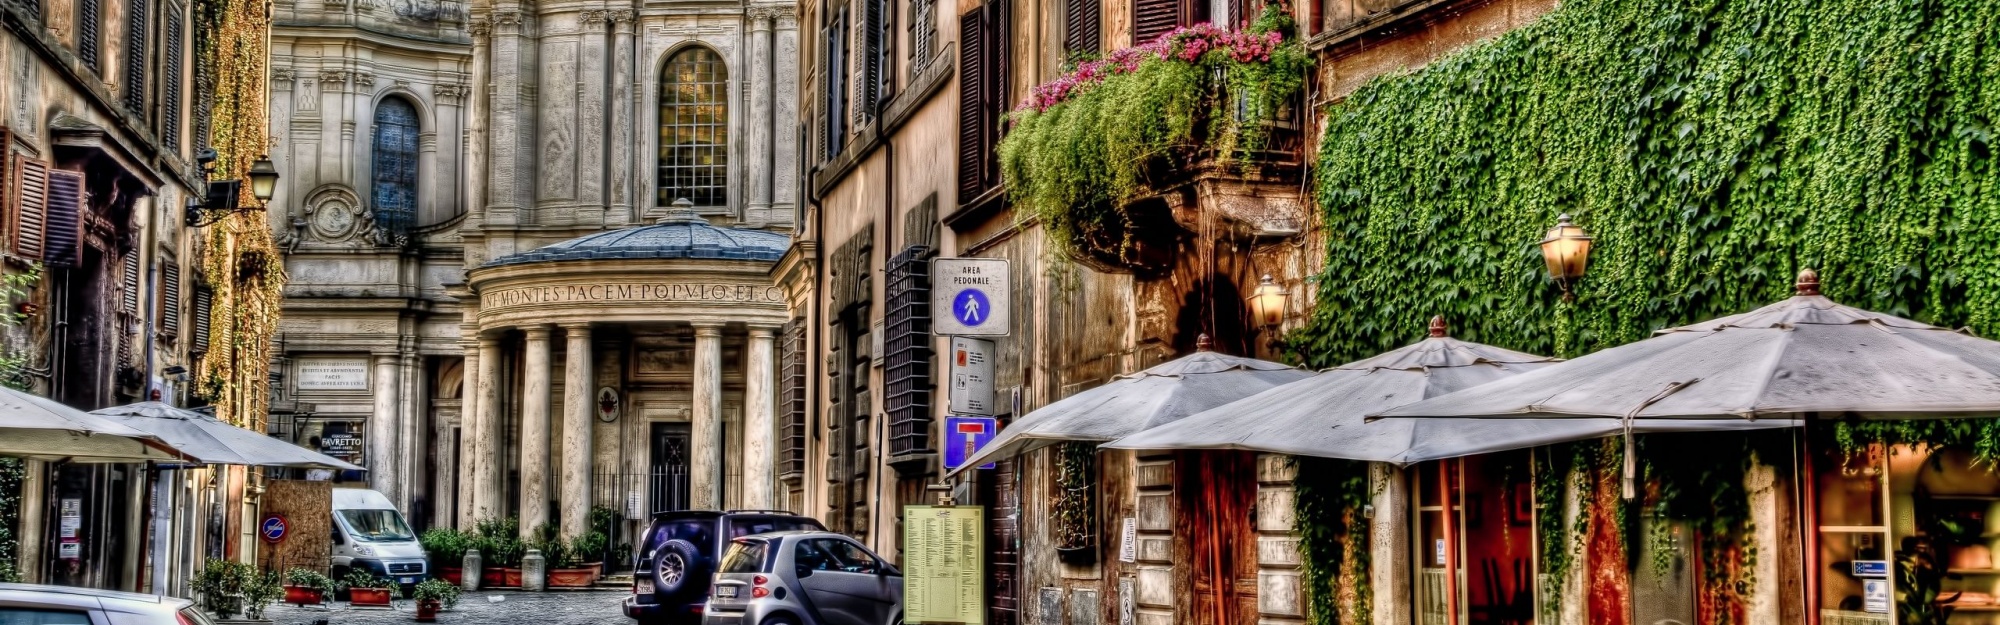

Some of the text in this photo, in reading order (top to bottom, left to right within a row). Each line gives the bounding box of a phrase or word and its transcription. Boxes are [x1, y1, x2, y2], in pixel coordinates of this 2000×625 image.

[963, 266, 980, 274] AREA
[954, 276, 989, 285] PEDONALE
[501, 286, 559, 306] MONTES
[567, 284, 632, 300] PACEM
[641, 284, 726, 300] POPVLO
[736, 285, 754, 300] ET
[322, 438, 361, 446] FAVRETTO
